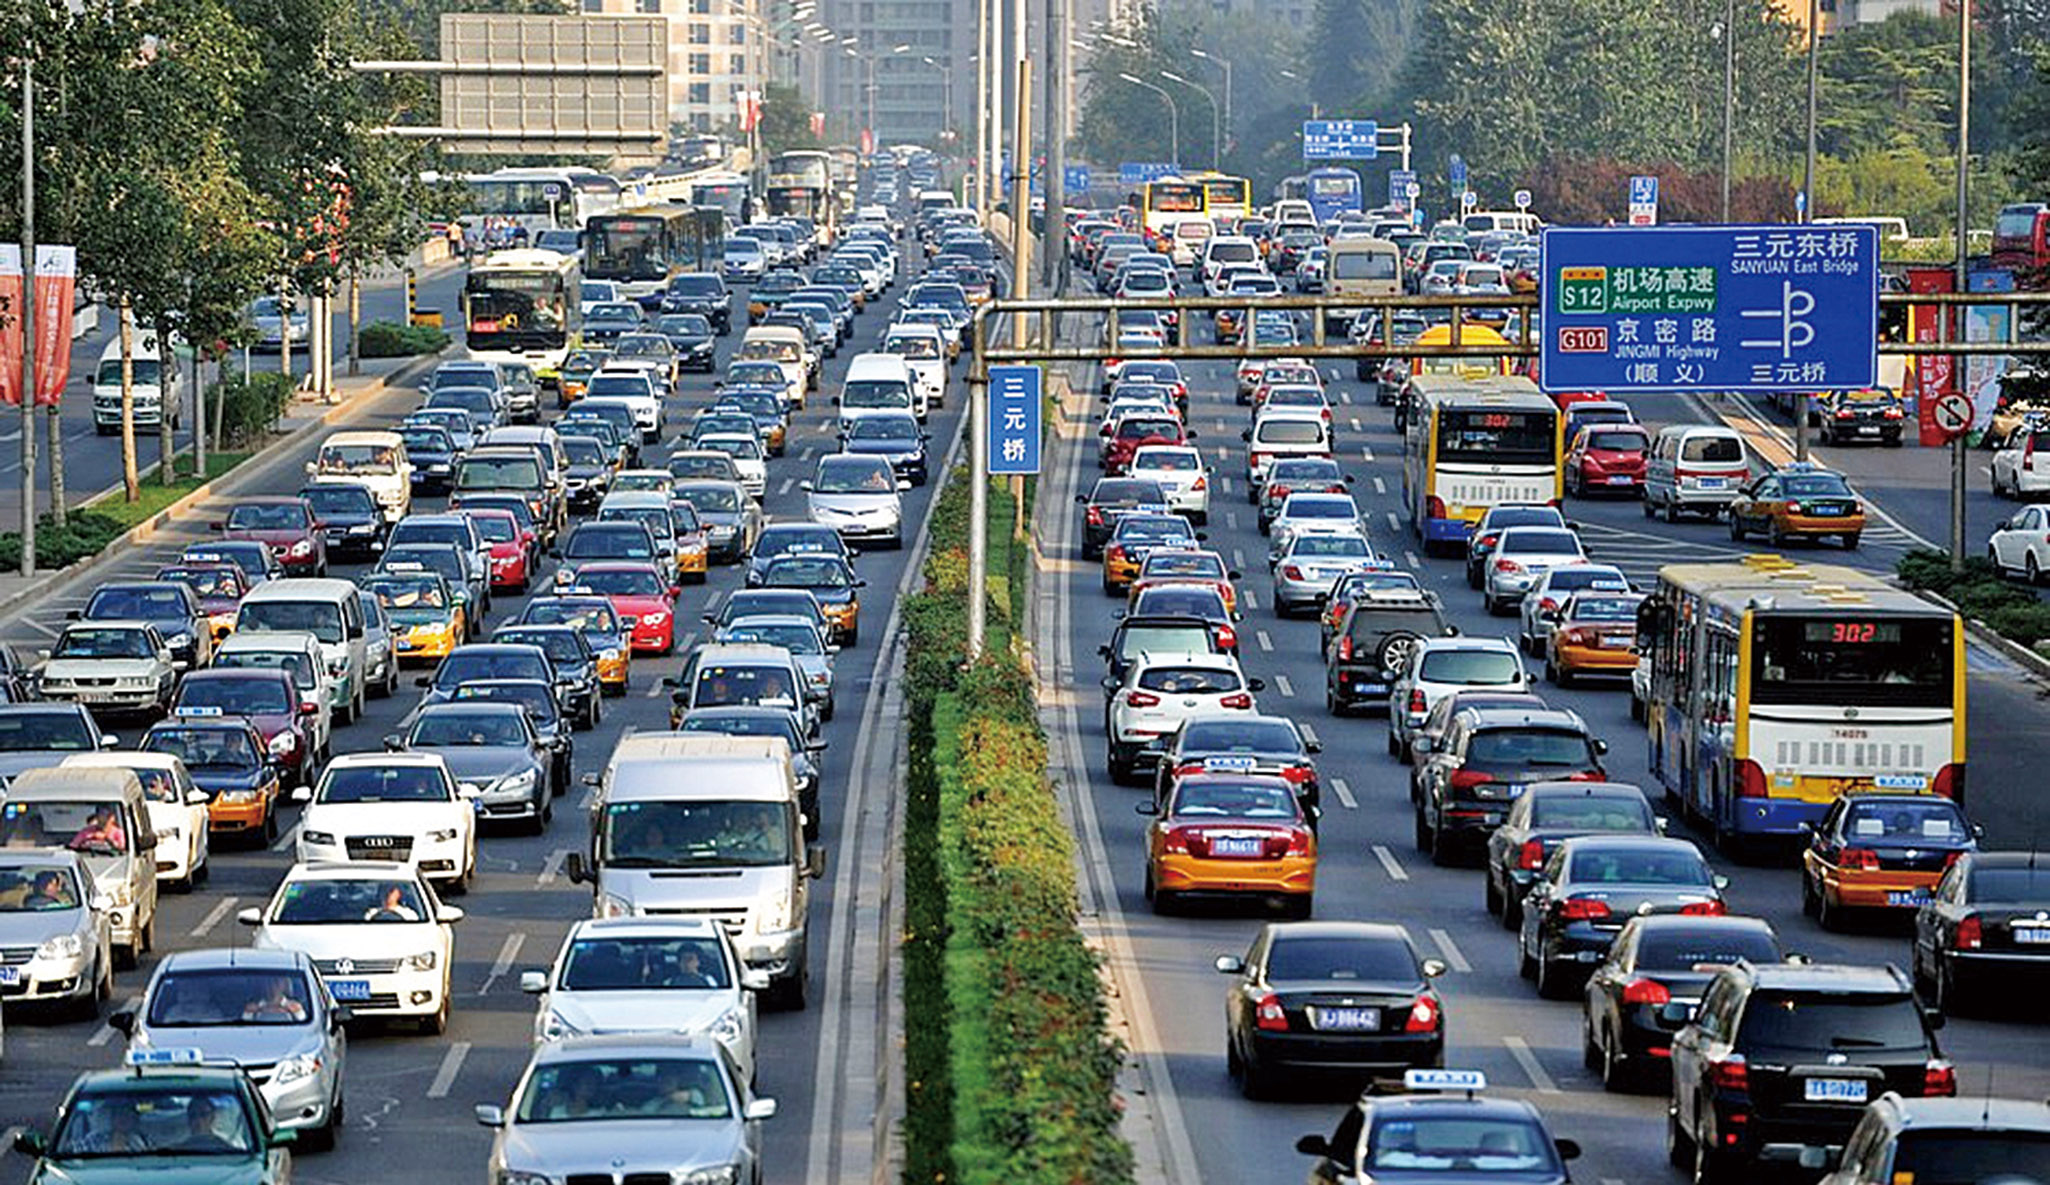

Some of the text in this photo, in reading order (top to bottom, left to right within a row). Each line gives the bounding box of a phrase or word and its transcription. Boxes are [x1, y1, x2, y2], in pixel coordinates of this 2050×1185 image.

[1733, 232, 1859, 258] 三元东桥
[1731, 259, 1859, 275] SANYUAN East Bridge
[1612, 266, 1715, 293] 机场高速
[1564, 286, 1602, 306] S12
[1612, 295, 1715, 312] Airport Expwy
[1562, 331, 1605, 348] G101
[1616, 317, 1716, 343] 京密路
[1615, 345, 1719, 361] JINGMI Highway
[1750, 362, 1826, 383] 三元桥
[1003, 378, 1026, 461] 三元桥
[1484, 414, 1511, 427] 302
[1832, 623, 1876, 642] 302
